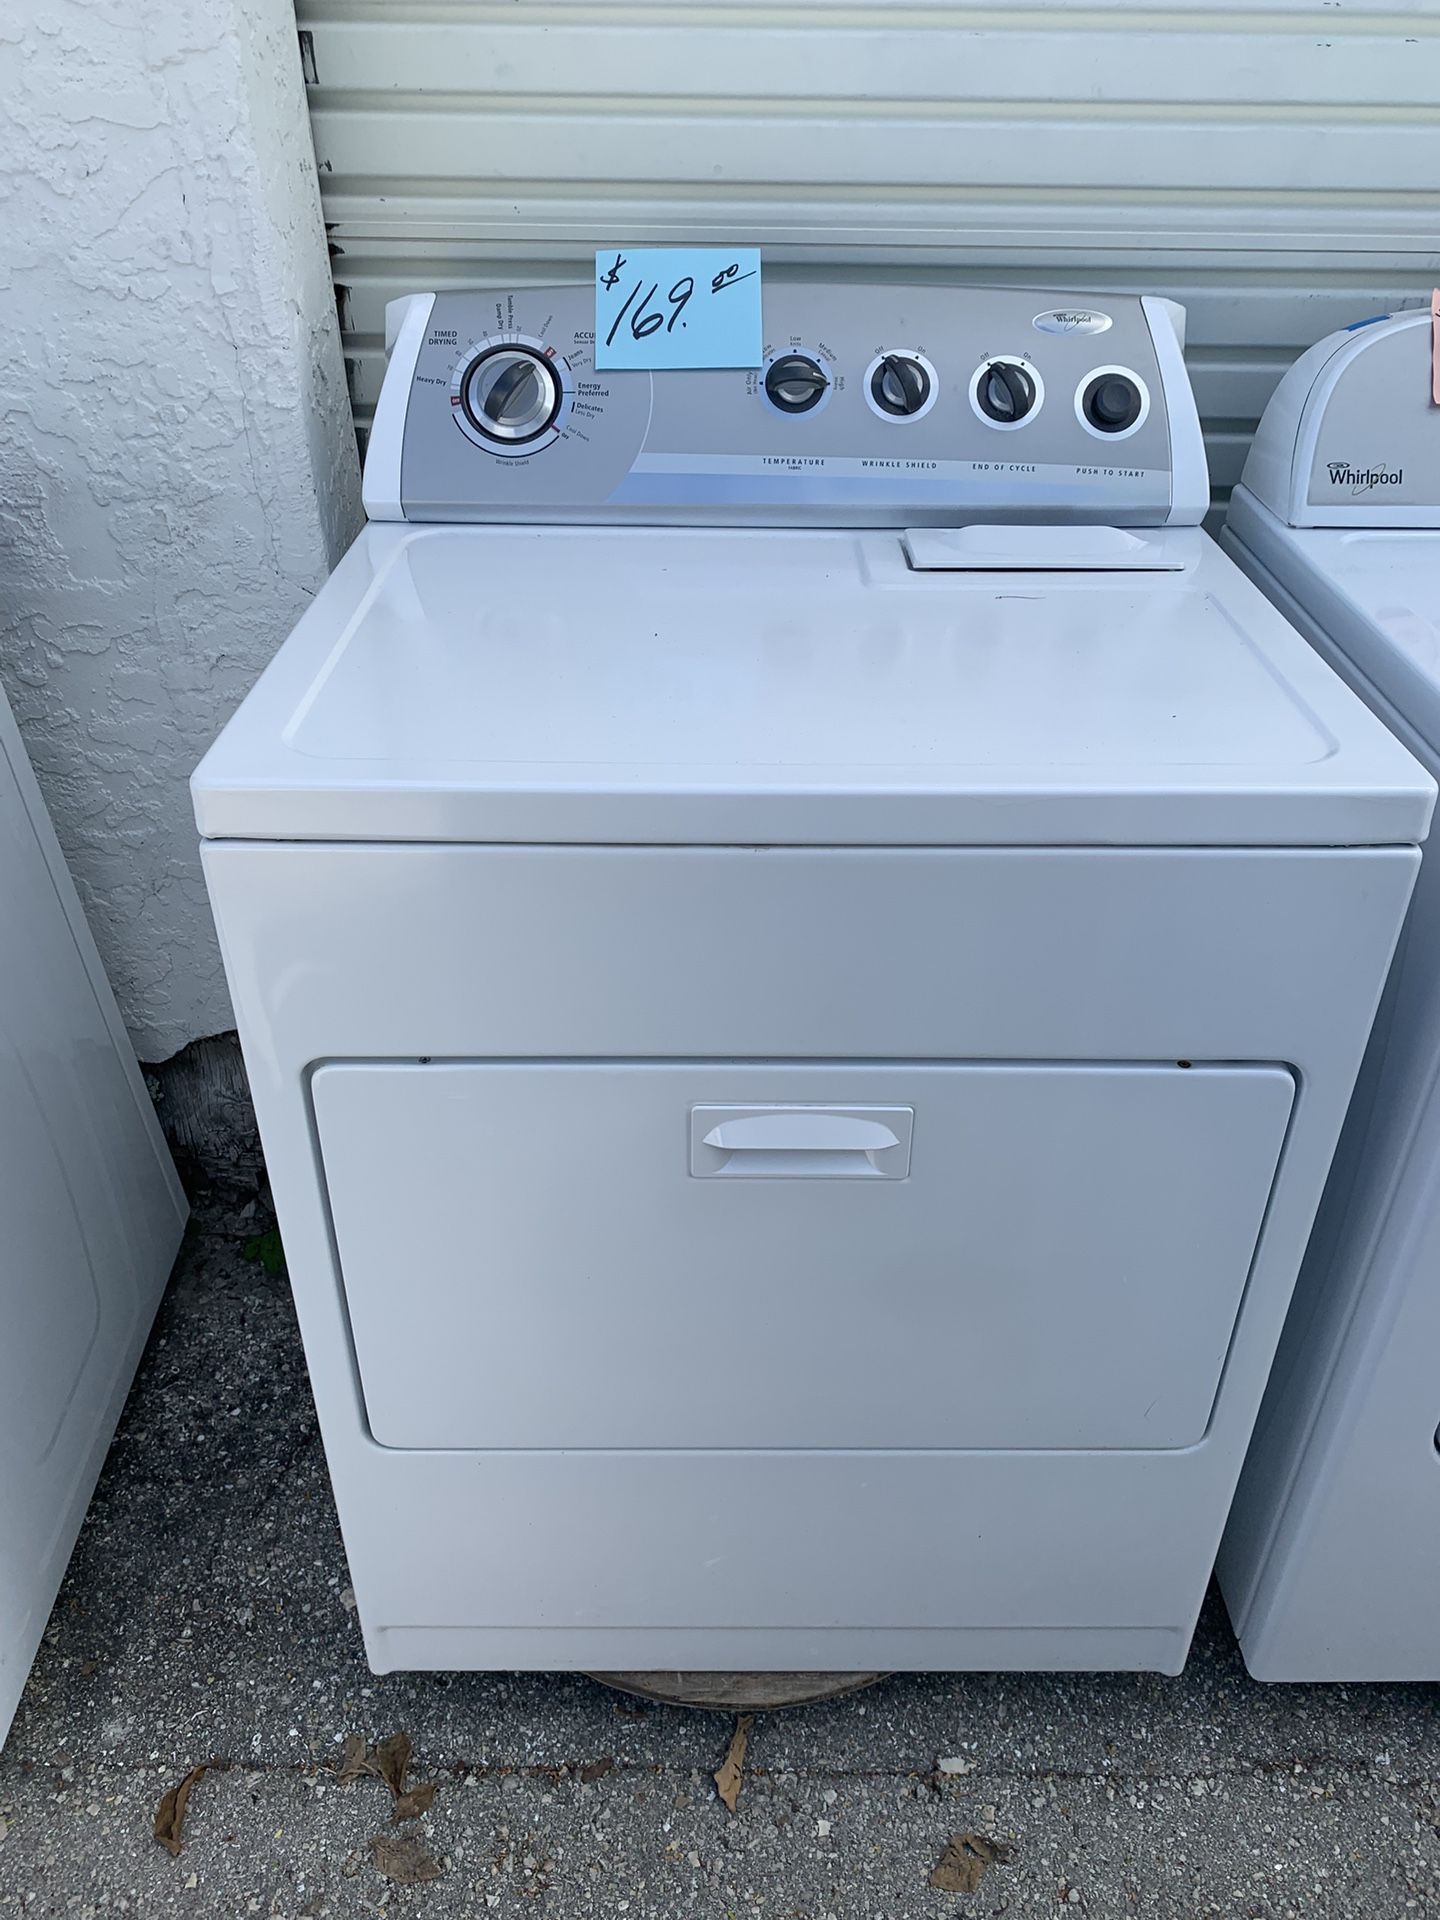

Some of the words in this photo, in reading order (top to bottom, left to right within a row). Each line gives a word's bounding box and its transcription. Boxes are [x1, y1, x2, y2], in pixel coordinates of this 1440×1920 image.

[428, 338, 457, 346] DRYING
[818, 343, 838, 361] Medium
[875, 346, 884, 354] Off
[568, 349, 584, 361] Jeans
[980, 352, 990, 361] Off
[1023, 352, 1032, 360] On
[571, 361, 582, 369] Very
[581, 357, 592, 366] Dry
[416, 375, 433, 384] Heavy
[433, 378, 447, 387] Dry
[578, 382, 601, 391] Energy
[576, 403, 604, 413] Delicates
[585, 411, 595, 419] Dry
[763, 458, 825, 466] TEMPERATURE
[862, 460, 900, 468] WRINKLE
[906, 461, 937, 469] SHIELD
[1076, 467, 1099, 475] PUSH
[1118, 470, 1145, 478] START
[1329, 469, 1402, 489] Whirlpool
